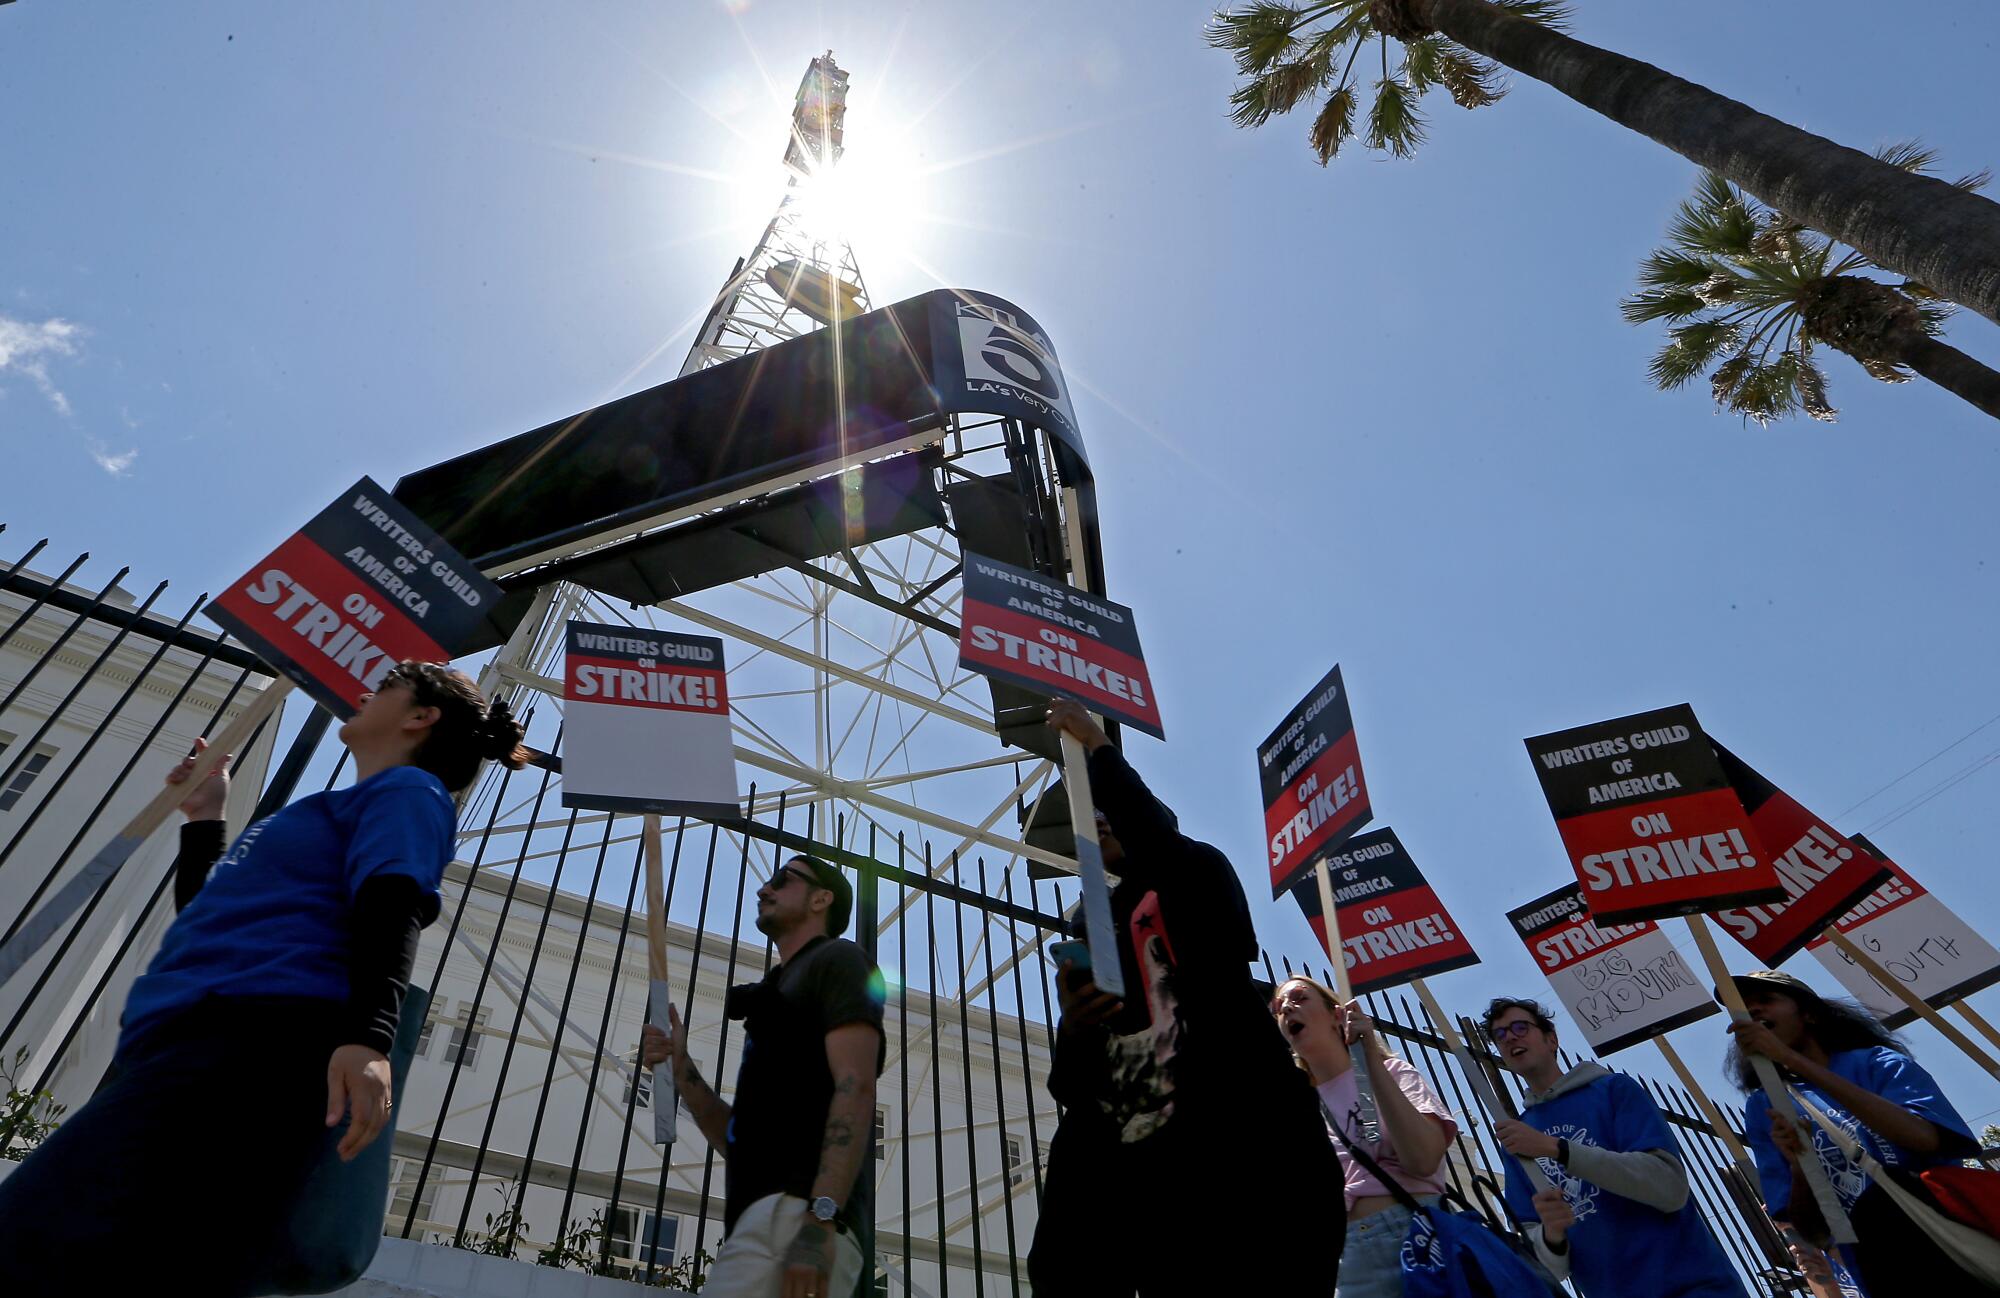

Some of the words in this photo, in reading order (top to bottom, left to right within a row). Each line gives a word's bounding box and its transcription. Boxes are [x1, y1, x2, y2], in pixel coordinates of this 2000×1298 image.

[966, 381, 1011, 396] LA's
[1012, 389, 1048, 413] Very
[353, 495, 434, 564] WRITERS
[430, 561, 481, 607] GUILD
[393, 556, 418, 575] OF
[344, 546, 430, 618] AMERICA
[975, 563, 1064, 600] WRITERS
[1068, 595, 1124, 624] GUILD
[342, 593, 384, 629] ON
[1007, 597, 1101, 639] AMERICA
[1042, 597, 1063, 610] OF
[576, 632, 660, 656] WRITERS
[662, 642, 714, 662] GUILD
[1039, 628, 1078, 651] ON
[638, 657, 656, 669] ON
[970, 625, 1148, 708] STRIKE!
[575, 664, 719, 709] STRIKE!
[1262, 715, 1305, 767] WRITERS
[1305, 685, 1337, 723] GUILD
[1294, 733, 1306, 751] OF
[1280, 732, 1328, 787] AMERICA
[1540, 736, 1629, 769] WRITERS
[1630, 724, 1690, 750] GUILD
[1611, 759, 1633, 775] OF
[1298, 773, 1318, 802] ON
[1588, 771, 1682, 804] AMERICA
[1271, 765, 1360, 867] STRIKE!
[1631, 812, 1672, 837] ON
[1353, 842, 1394, 862] GUILD
[1581, 828, 1757, 891] STRIKE!
[1331, 876, 1394, 903] AMERICA
[1343, 869, 1359, 881] OF
[1363, 905, 1392, 925] ON
[1518, 896, 1579, 931] WRITERS
[1569, 911, 1584, 924] ON
[1572, 948, 1632, 991] BIG
[1576, 951, 1696, 1031] MOUTH
[1562, 1124, 1576, 1133] OF
